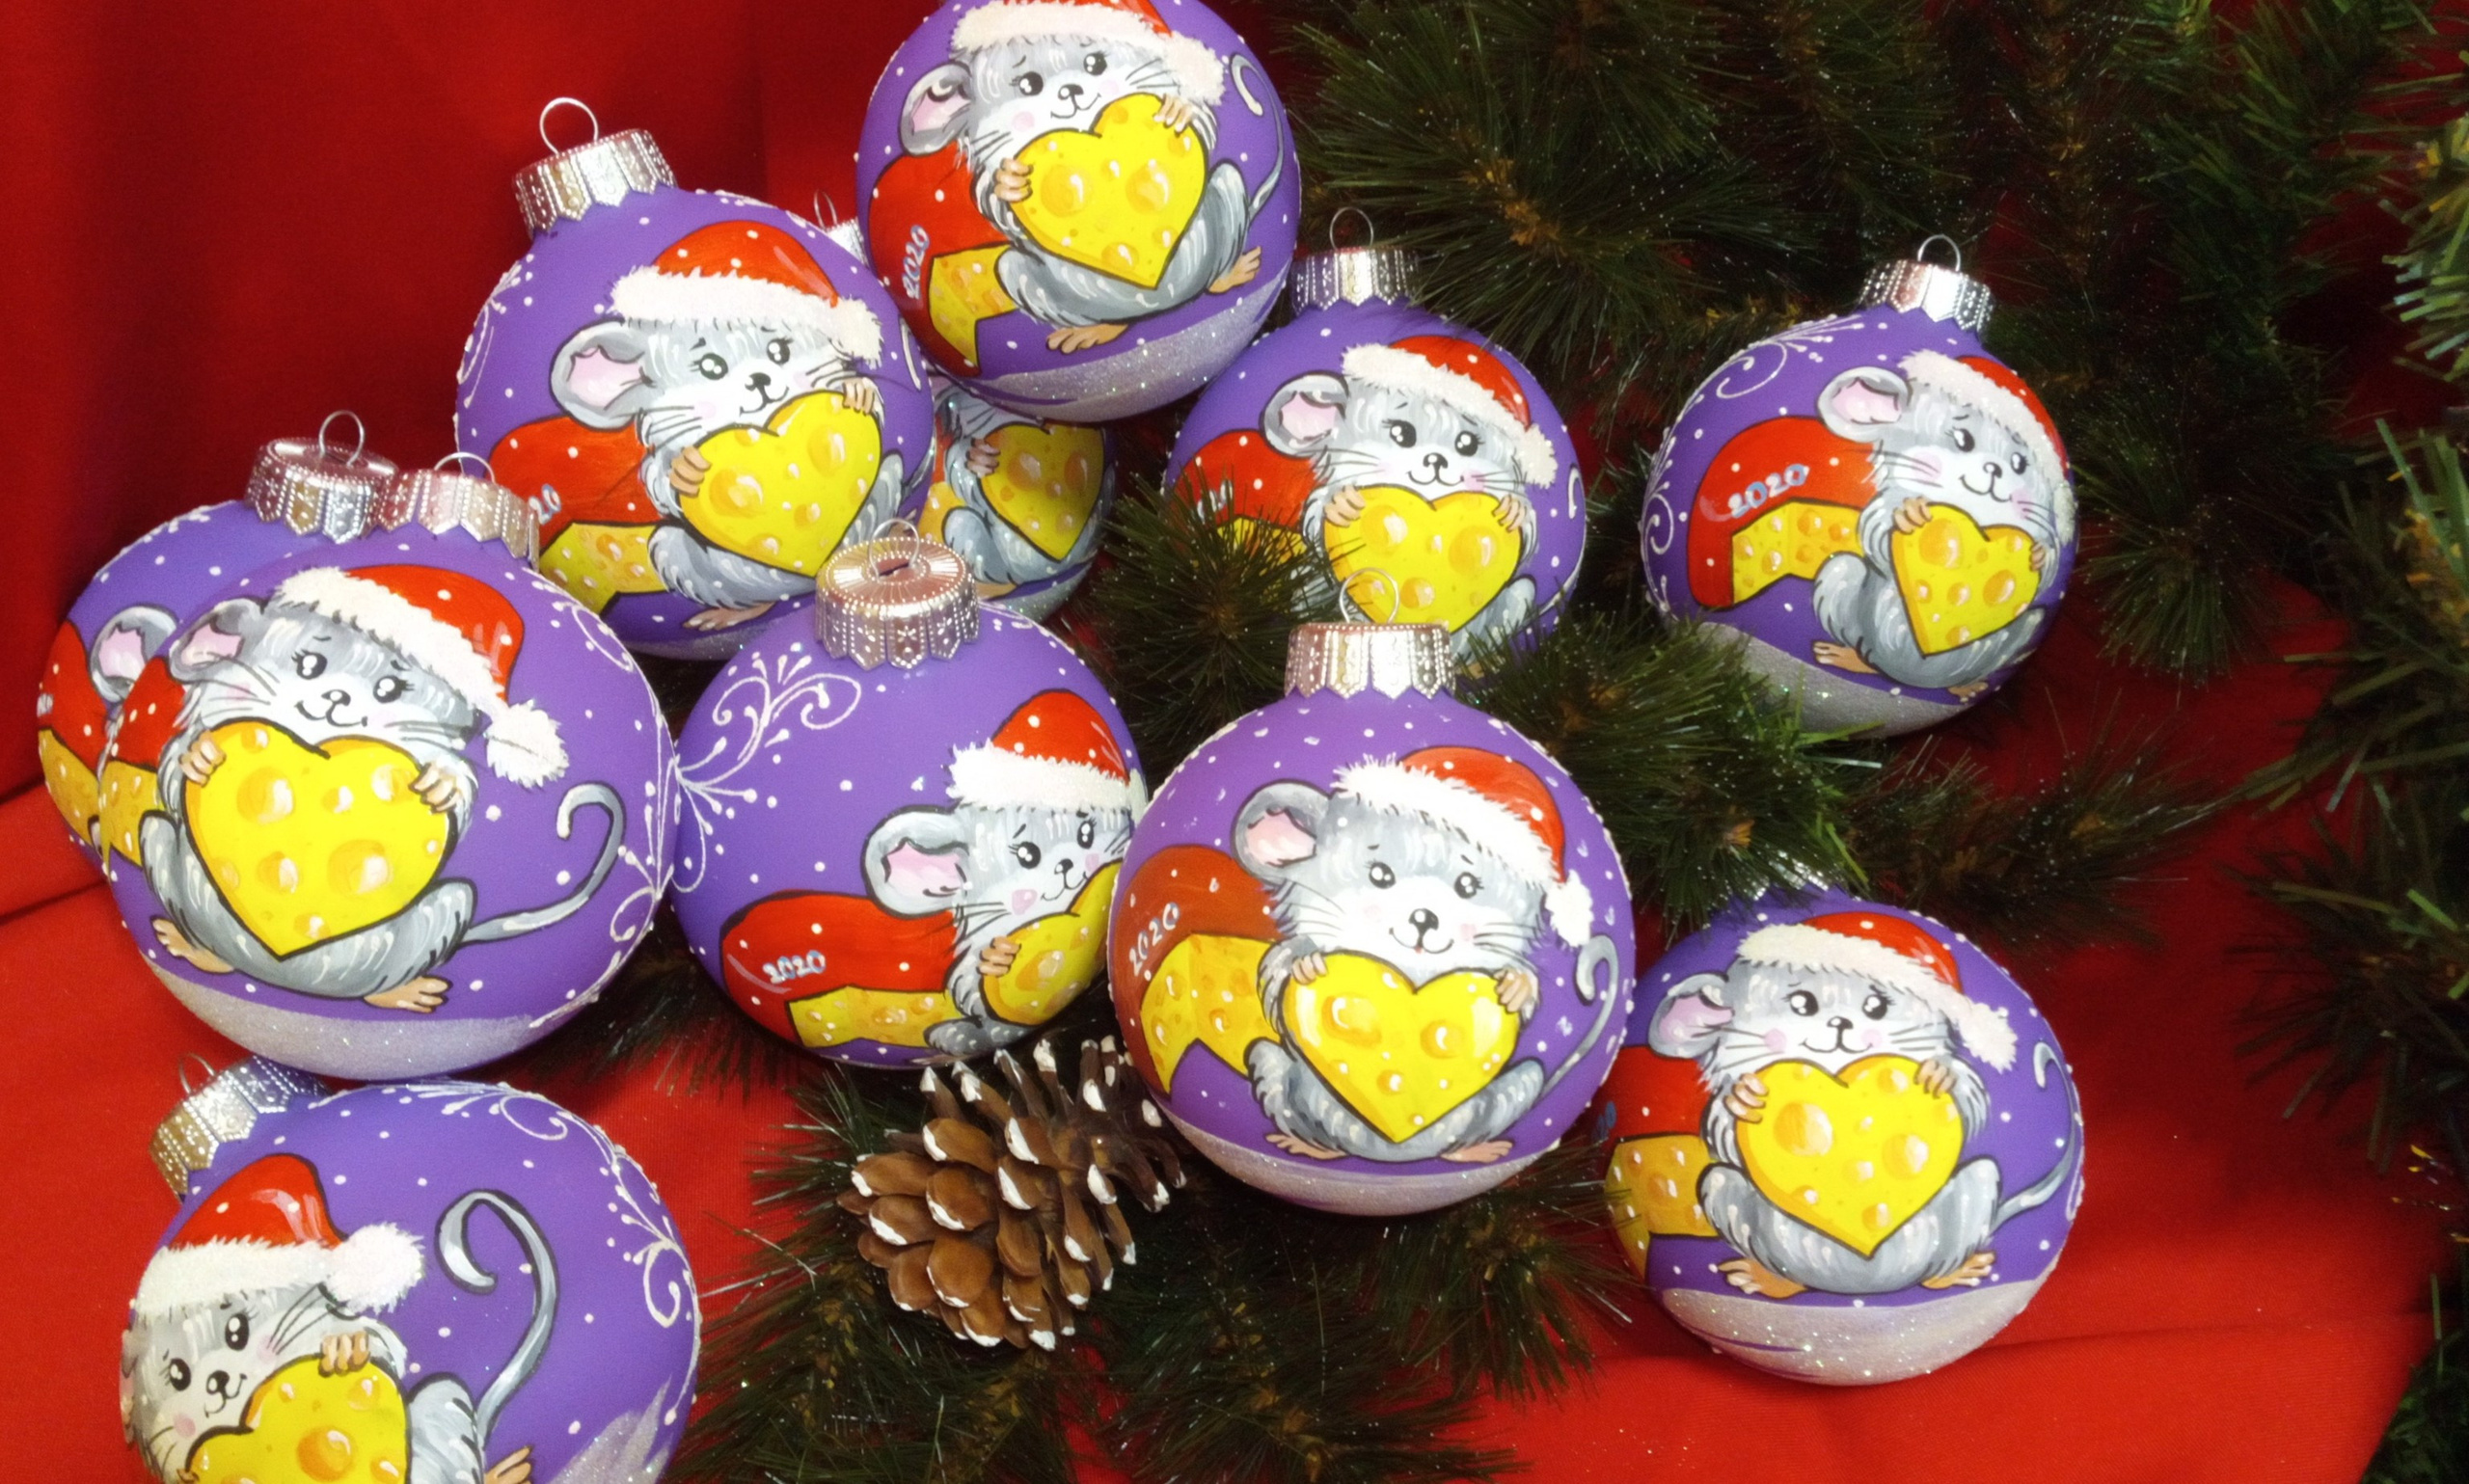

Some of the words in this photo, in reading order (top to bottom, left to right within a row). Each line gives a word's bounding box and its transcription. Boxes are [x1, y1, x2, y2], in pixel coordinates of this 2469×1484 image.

[901, 225, 930, 300] 2020
[528, 483, 561, 526] 20
[1727, 464, 1809, 518] 2020
[1128, 902, 1180, 977] 2020
[762, 950, 827, 984] 2020
